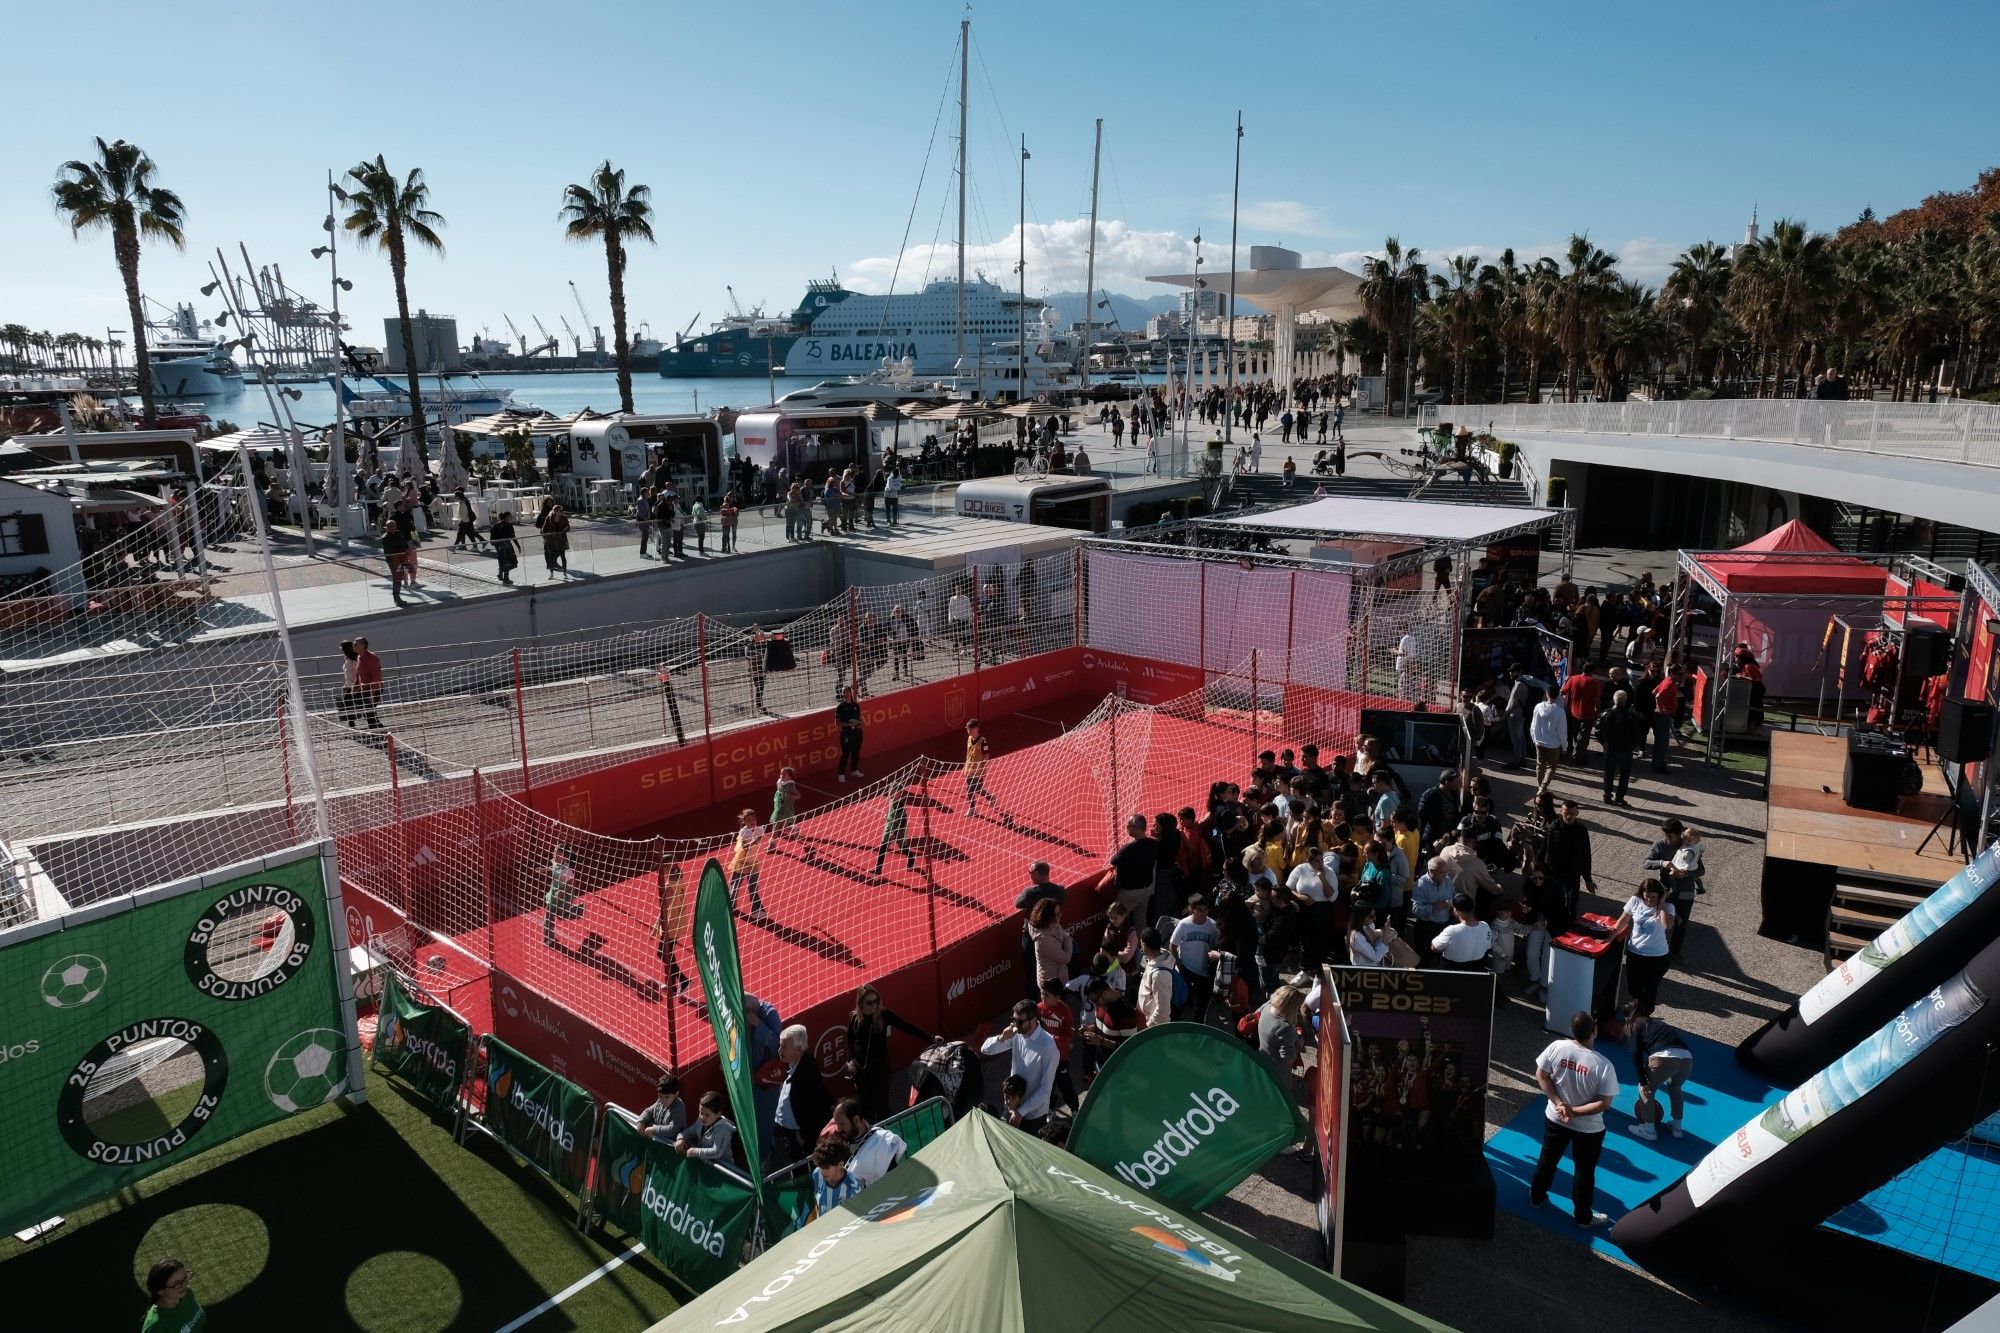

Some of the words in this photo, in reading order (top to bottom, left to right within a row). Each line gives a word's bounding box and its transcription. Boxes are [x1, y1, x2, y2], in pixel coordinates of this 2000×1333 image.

[805, 340, 822, 359] 25
[425, 404, 463, 412] quatro
[985, 504, 1006, 513] BIKES
[640, 734, 789, 790] SELECCIÓN
[798, 702, 912, 744] ESPÑOLA
[722, 771, 754, 790] DE
[763, 744, 842, 776] FÚTBO
[190, 918, 215, 944] 50
[215, 886, 302, 916] PUNTOS
[287, 942, 310, 967] 50
[198, 969, 288, 999] PUNTOS
[966, 958, 1012, 989] Iberdrola
[1370, 992, 1452, 1013] 2023
[69, 1060, 97, 1087] 25
[106, 1019, 202, 1052] PUNTOS
[822, 1035, 844, 1052] RF
[823, 1050, 845, 1068] EF
[1560, 1057, 1589, 1075] SEUR
[193, 1094, 218, 1120] 25
[87, 1128, 187, 1163] PUNTOS
[1114, 1086, 1240, 1190] Iberdrola
[641, 1174, 727, 1259] Iberdrola
[1046, 1164, 1242, 1264] IBERDROLA
[714, 1194, 909, 1327] IBERDROLA
